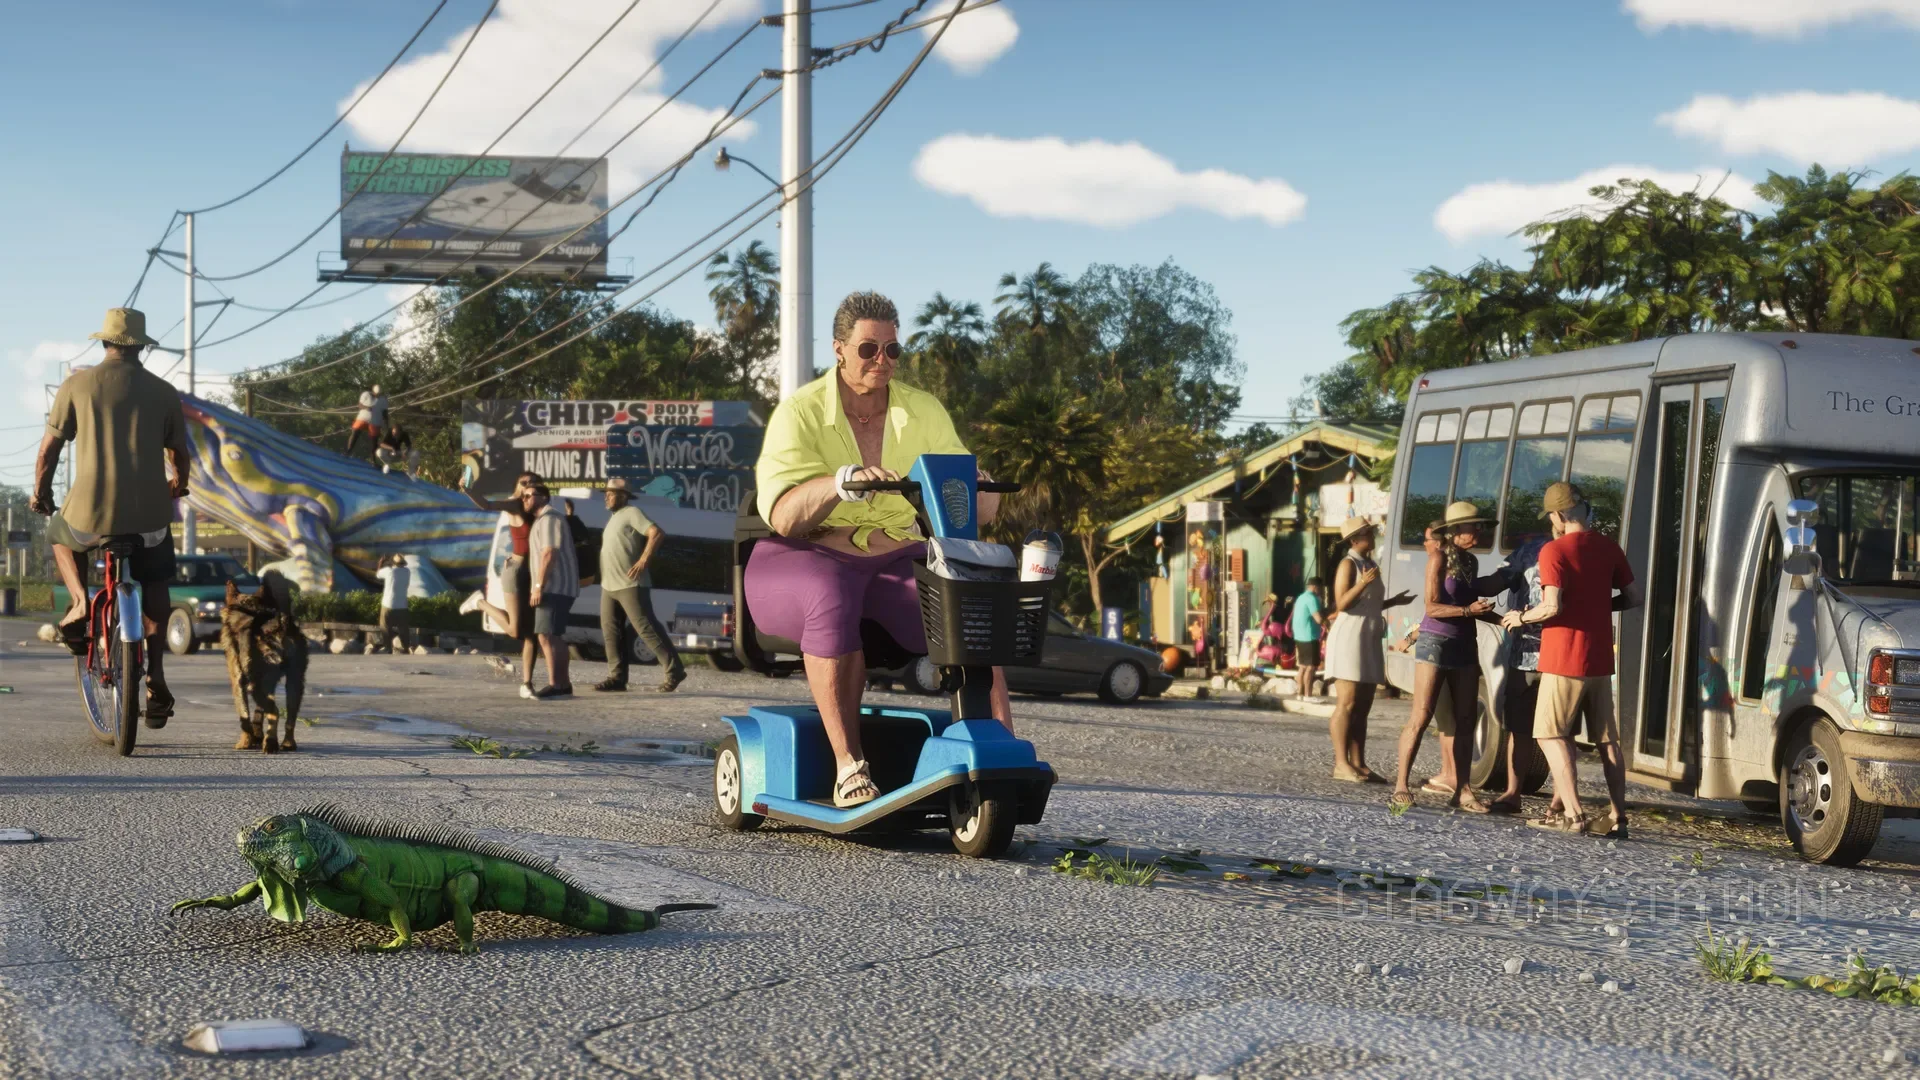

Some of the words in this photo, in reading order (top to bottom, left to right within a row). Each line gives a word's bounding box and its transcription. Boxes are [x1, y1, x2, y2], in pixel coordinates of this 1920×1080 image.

[347, 155, 409, 174] KEEPS
[411, 157, 511, 177] BUSINESS
[654, 403, 700, 416] BODY
[1826, 391, 1875, 413] The
[526, 402, 648, 426] CHIP'S
[653, 415, 699, 425] SHOP
[524, 450, 581, 479] HAVING
[584, 450, 596, 479] A
